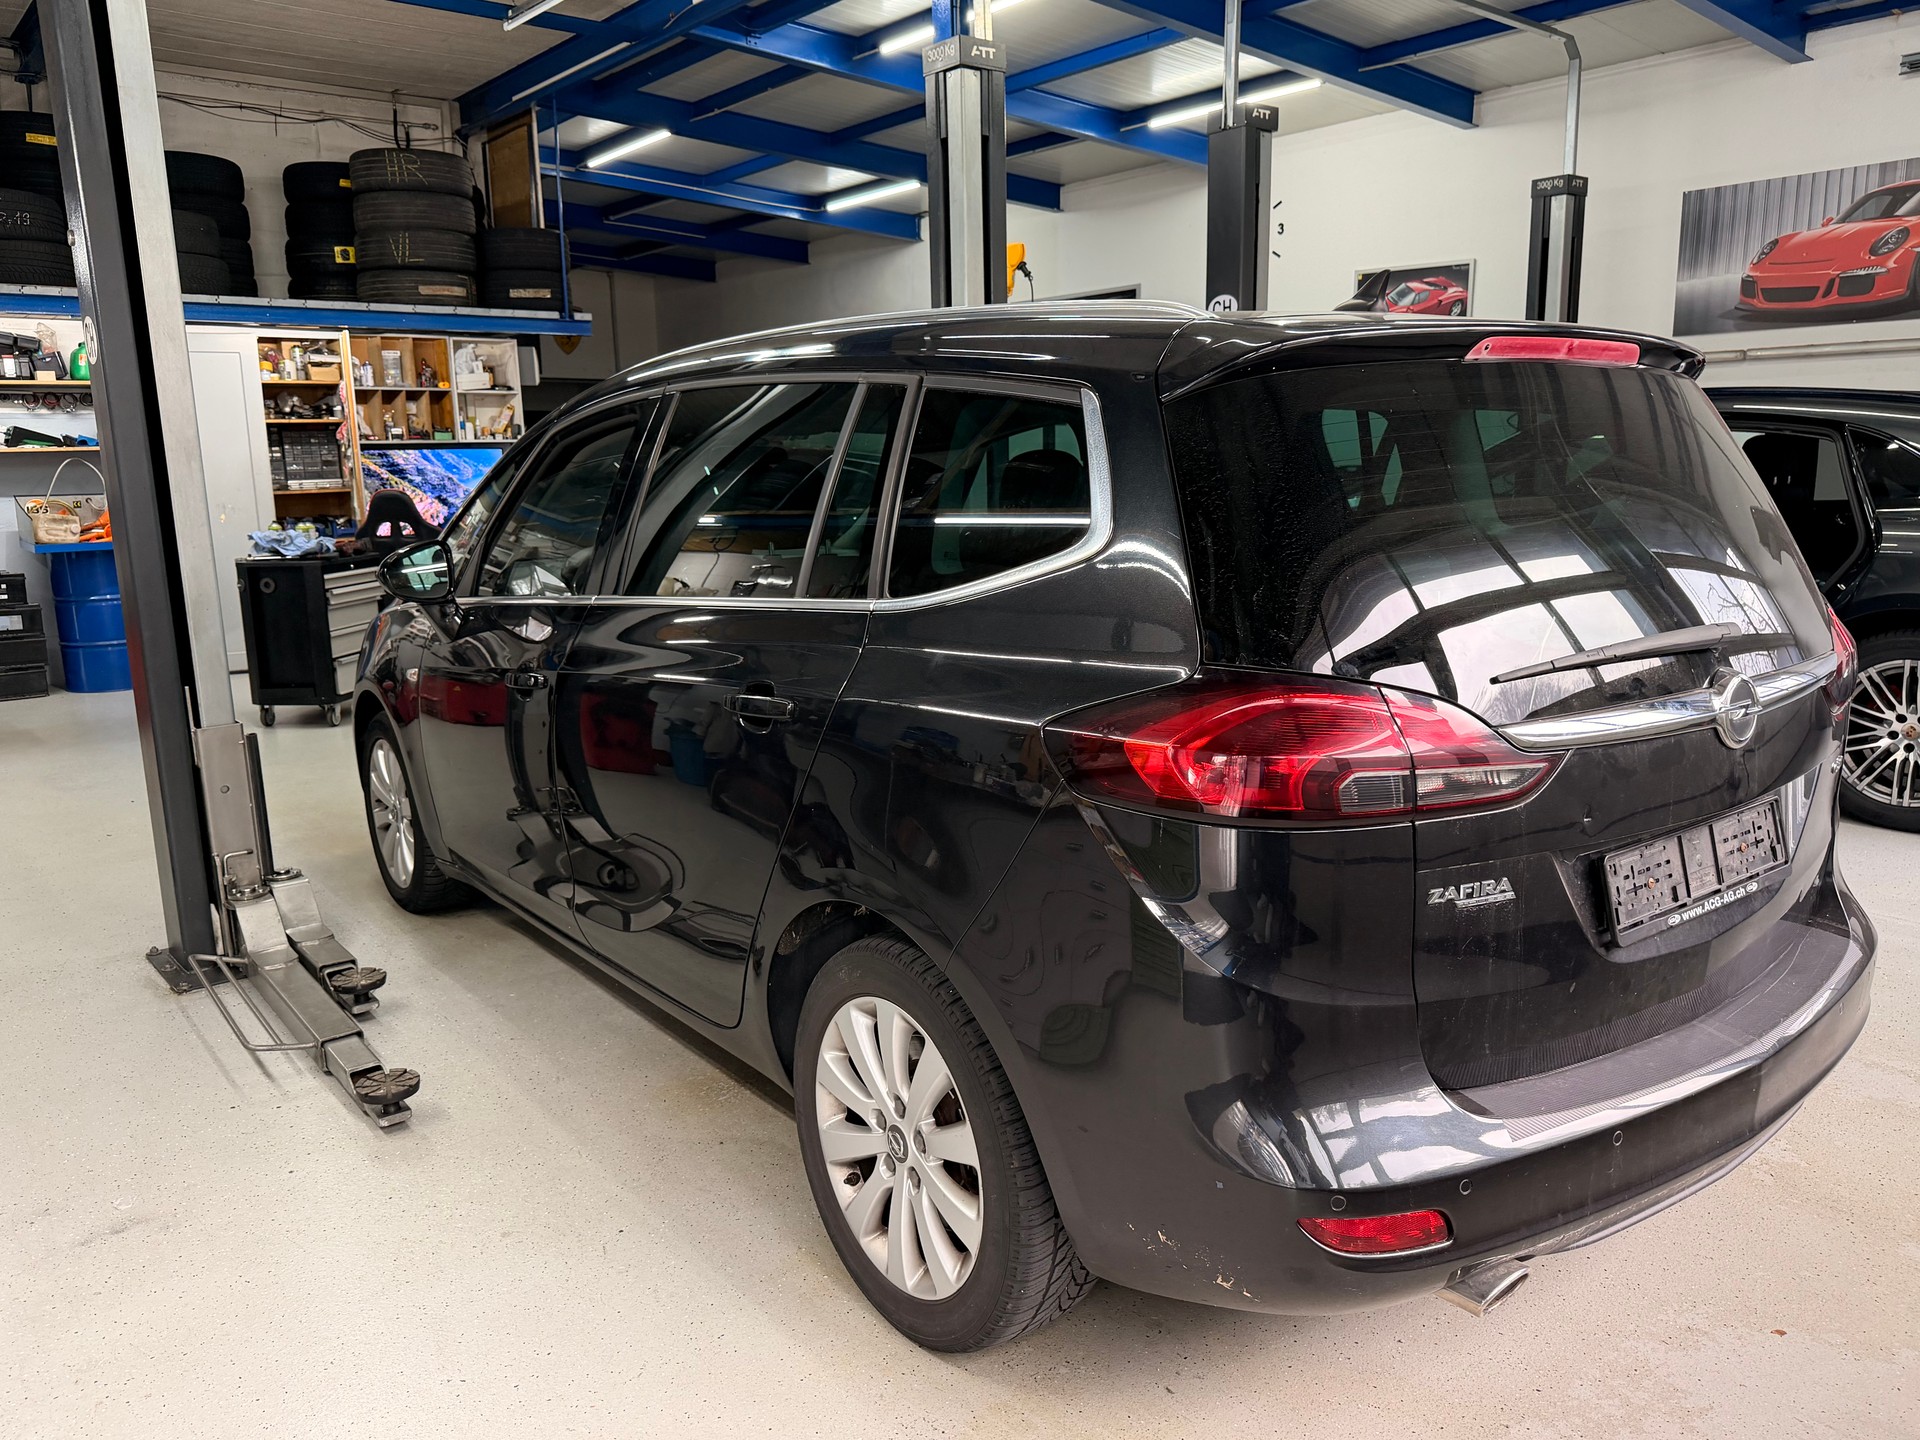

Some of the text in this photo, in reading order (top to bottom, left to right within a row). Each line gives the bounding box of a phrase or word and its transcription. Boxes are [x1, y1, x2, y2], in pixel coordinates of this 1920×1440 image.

[927, 42, 955, 62] 3000 Kg
[970, 45, 996, 60] ATT
[1252, 107, 1271, 120] ATT
[1536, 178, 1564, 190] 3000 Kg
[1571, 178, 1584, 188] ATT
[1277, 222, 1285, 235] 3
[1212, 298, 1232, 312] CH
[1427, 876, 1514, 905] ZAFIRA
[1681, 886, 1746, 921] www.ACG-AG.ch
